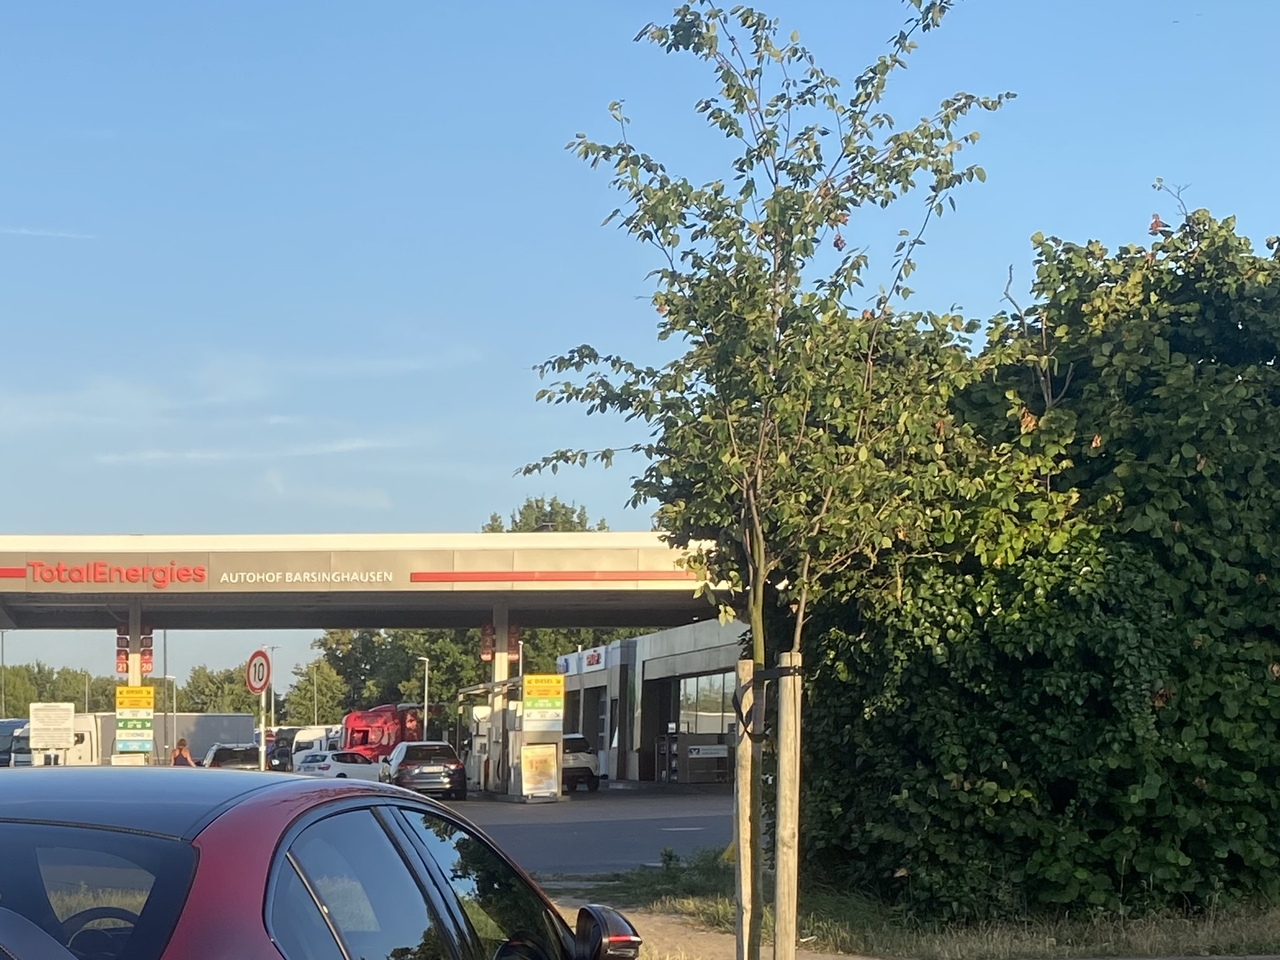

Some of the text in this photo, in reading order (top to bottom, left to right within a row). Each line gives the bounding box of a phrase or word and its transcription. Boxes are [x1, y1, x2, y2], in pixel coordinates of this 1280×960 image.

[27, 560, 207, 589] TotalEnergies
[220, 571, 393, 583] AUTOHOF BARSINGHAUSEN
[117, 663, 127, 672] 21
[141, 663, 152, 671] 20
[253, 662, 265, 682] 10
